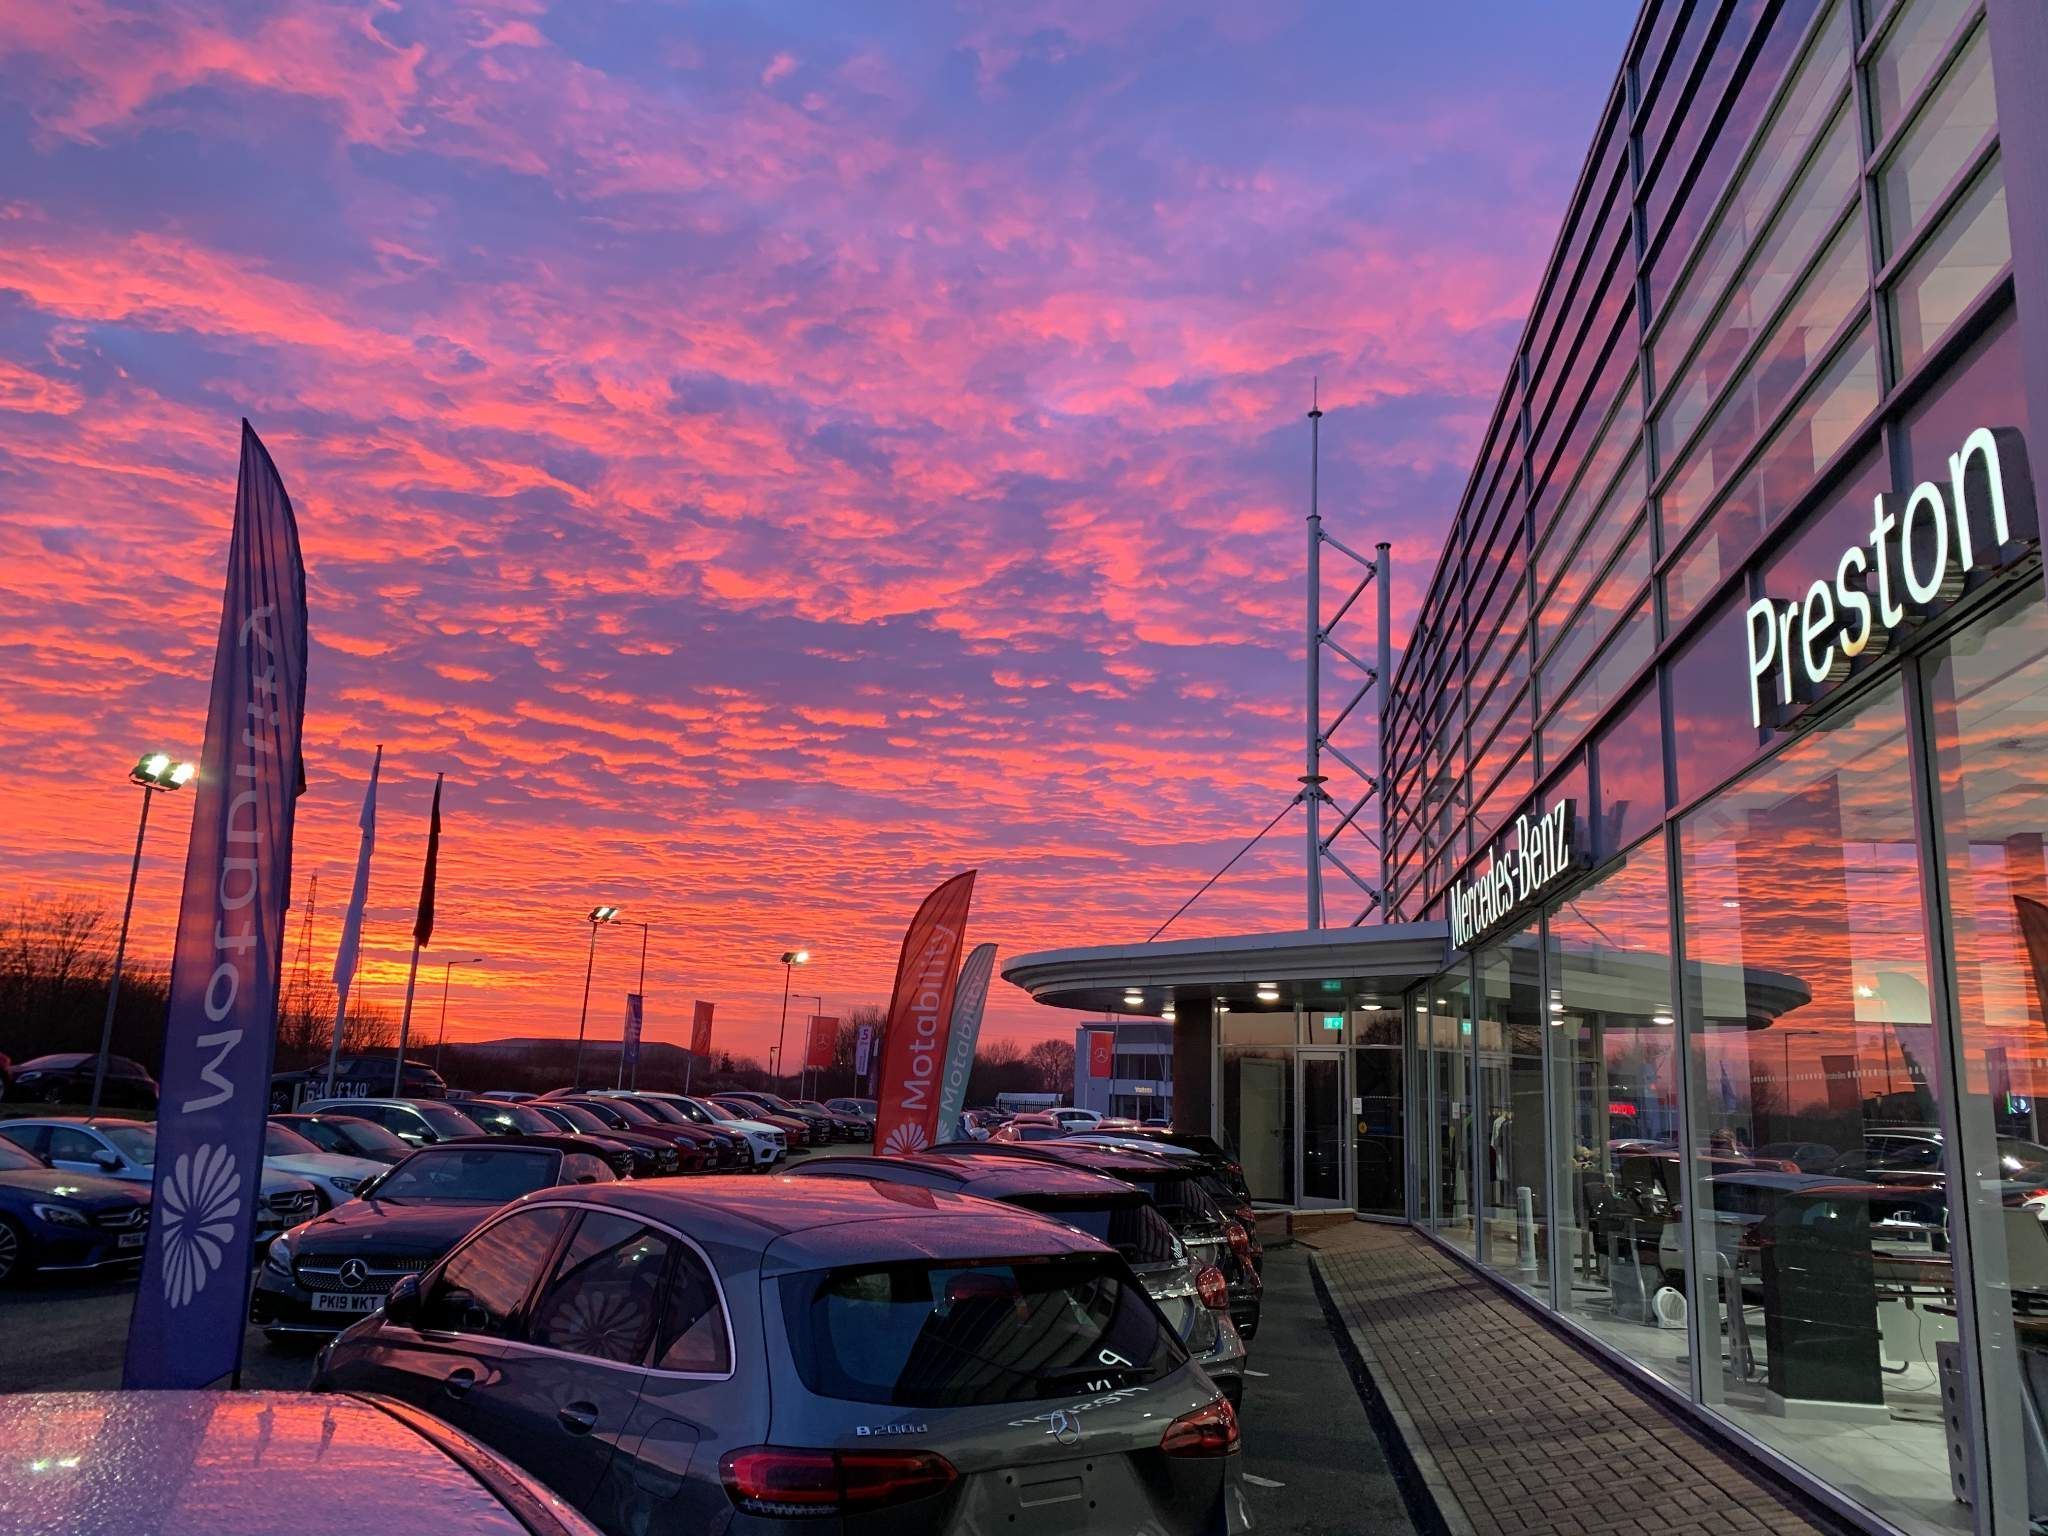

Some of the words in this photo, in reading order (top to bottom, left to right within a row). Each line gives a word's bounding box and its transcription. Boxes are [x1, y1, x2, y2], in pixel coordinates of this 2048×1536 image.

[1747, 427, 2009, 728] Preston
[1450, 799, 1569, 951] Mercedes-Benz
[901, 923, 957, 1110] Motability
[941, 976, 985, 1112] Motability
[319, 1294, 348, 1309] PK19
[351, 1296, 379, 1309] WKT
